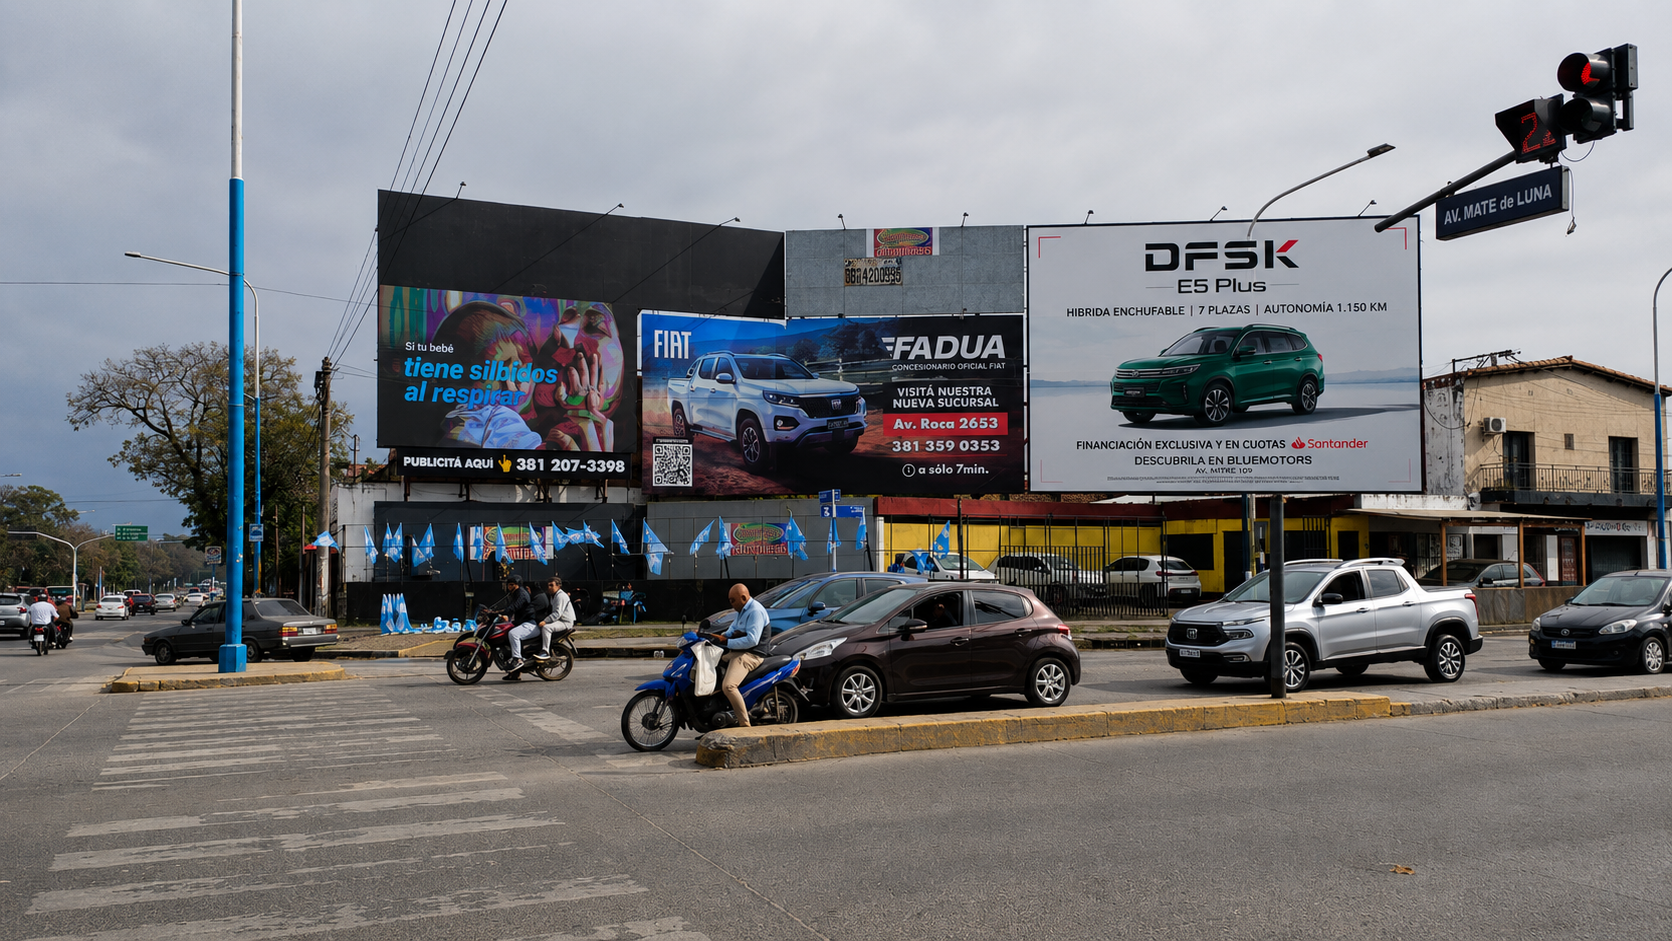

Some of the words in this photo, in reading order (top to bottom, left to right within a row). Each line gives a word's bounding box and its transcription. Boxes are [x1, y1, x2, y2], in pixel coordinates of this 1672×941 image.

[1444, 208, 1461, 225] AV.
[1464, 197, 1497, 221] MATE
[1500, 195, 1514, 210] de
[1517, 183, 1552, 205] LUNA
[1145, 239, 1299, 272] DFSK
[1177, 279, 1209, 294] E5
[1215, 278, 1267, 293] Plus
[1066, 307, 1110, 317] HIBRIDA
[1113, 306, 1185, 317] ENCHUFABLE
[1198, 305, 1205, 315] 7
[1208, 304, 1251, 315] PLAZAS
[1264, 302, 1334, 314] AUTONOMÍA
[1337, 302, 1367, 312] 1.150
[1369, 302, 1387, 312] KM
[405, 342, 415, 351] Si
[417, 343, 427, 353] tu
[429, 343, 454, 354] bebé
[654, 329, 692, 359] FIAT
[884, 334, 1006, 360] FADUA
[404, 356, 464, 380] tiene
[469, 360, 558, 384] silbidos
[892, 363, 956, 371] CONCESIONARIO
[957, 362, 987, 370] OFICIAL
[989, 362, 1006, 370] FIAT
[404, 381, 428, 402] al
[432, 384, 526, 410] respirar
[897, 384, 935, 397] VISITÁ
[938, 386, 992, 397] NUESTRA
[893, 398, 935, 409] NUEVA
[938, 397, 999, 408] SUCURSAL
[893, 418, 917, 430] Av.
[920, 418, 955, 430] Roca
[959, 417, 999, 429] 2653
[892, 440, 920, 453] 381
[925, 440, 955, 452] 359
[959, 439, 1000, 452] 0353
[1076, 438, 1151, 450] FINANCIACIÓN
[1155, 440, 1213, 450] EXCLUSIVA
[1216, 440, 1223, 449] Y
[1225, 440, 1240, 449] EN
[1242, 439, 1286, 449] CUOTAS
[1307, 438, 1369, 449] Santander
[403, 456, 462, 469] PUBLICITÁ
[464, 457, 494, 470] AQUÍ
[516, 458, 545, 472] 381
[551, 458, 626, 473] 207-3398
[1134, 455, 1205, 466] DESCUBRILA
[1208, 455, 1224, 465] EN
[1227, 455, 1312, 465] BLUEMOTORS
[918, 466, 926, 475] a
[928, 463, 953, 475] sólo
[956, 464, 989, 475] 7min.
